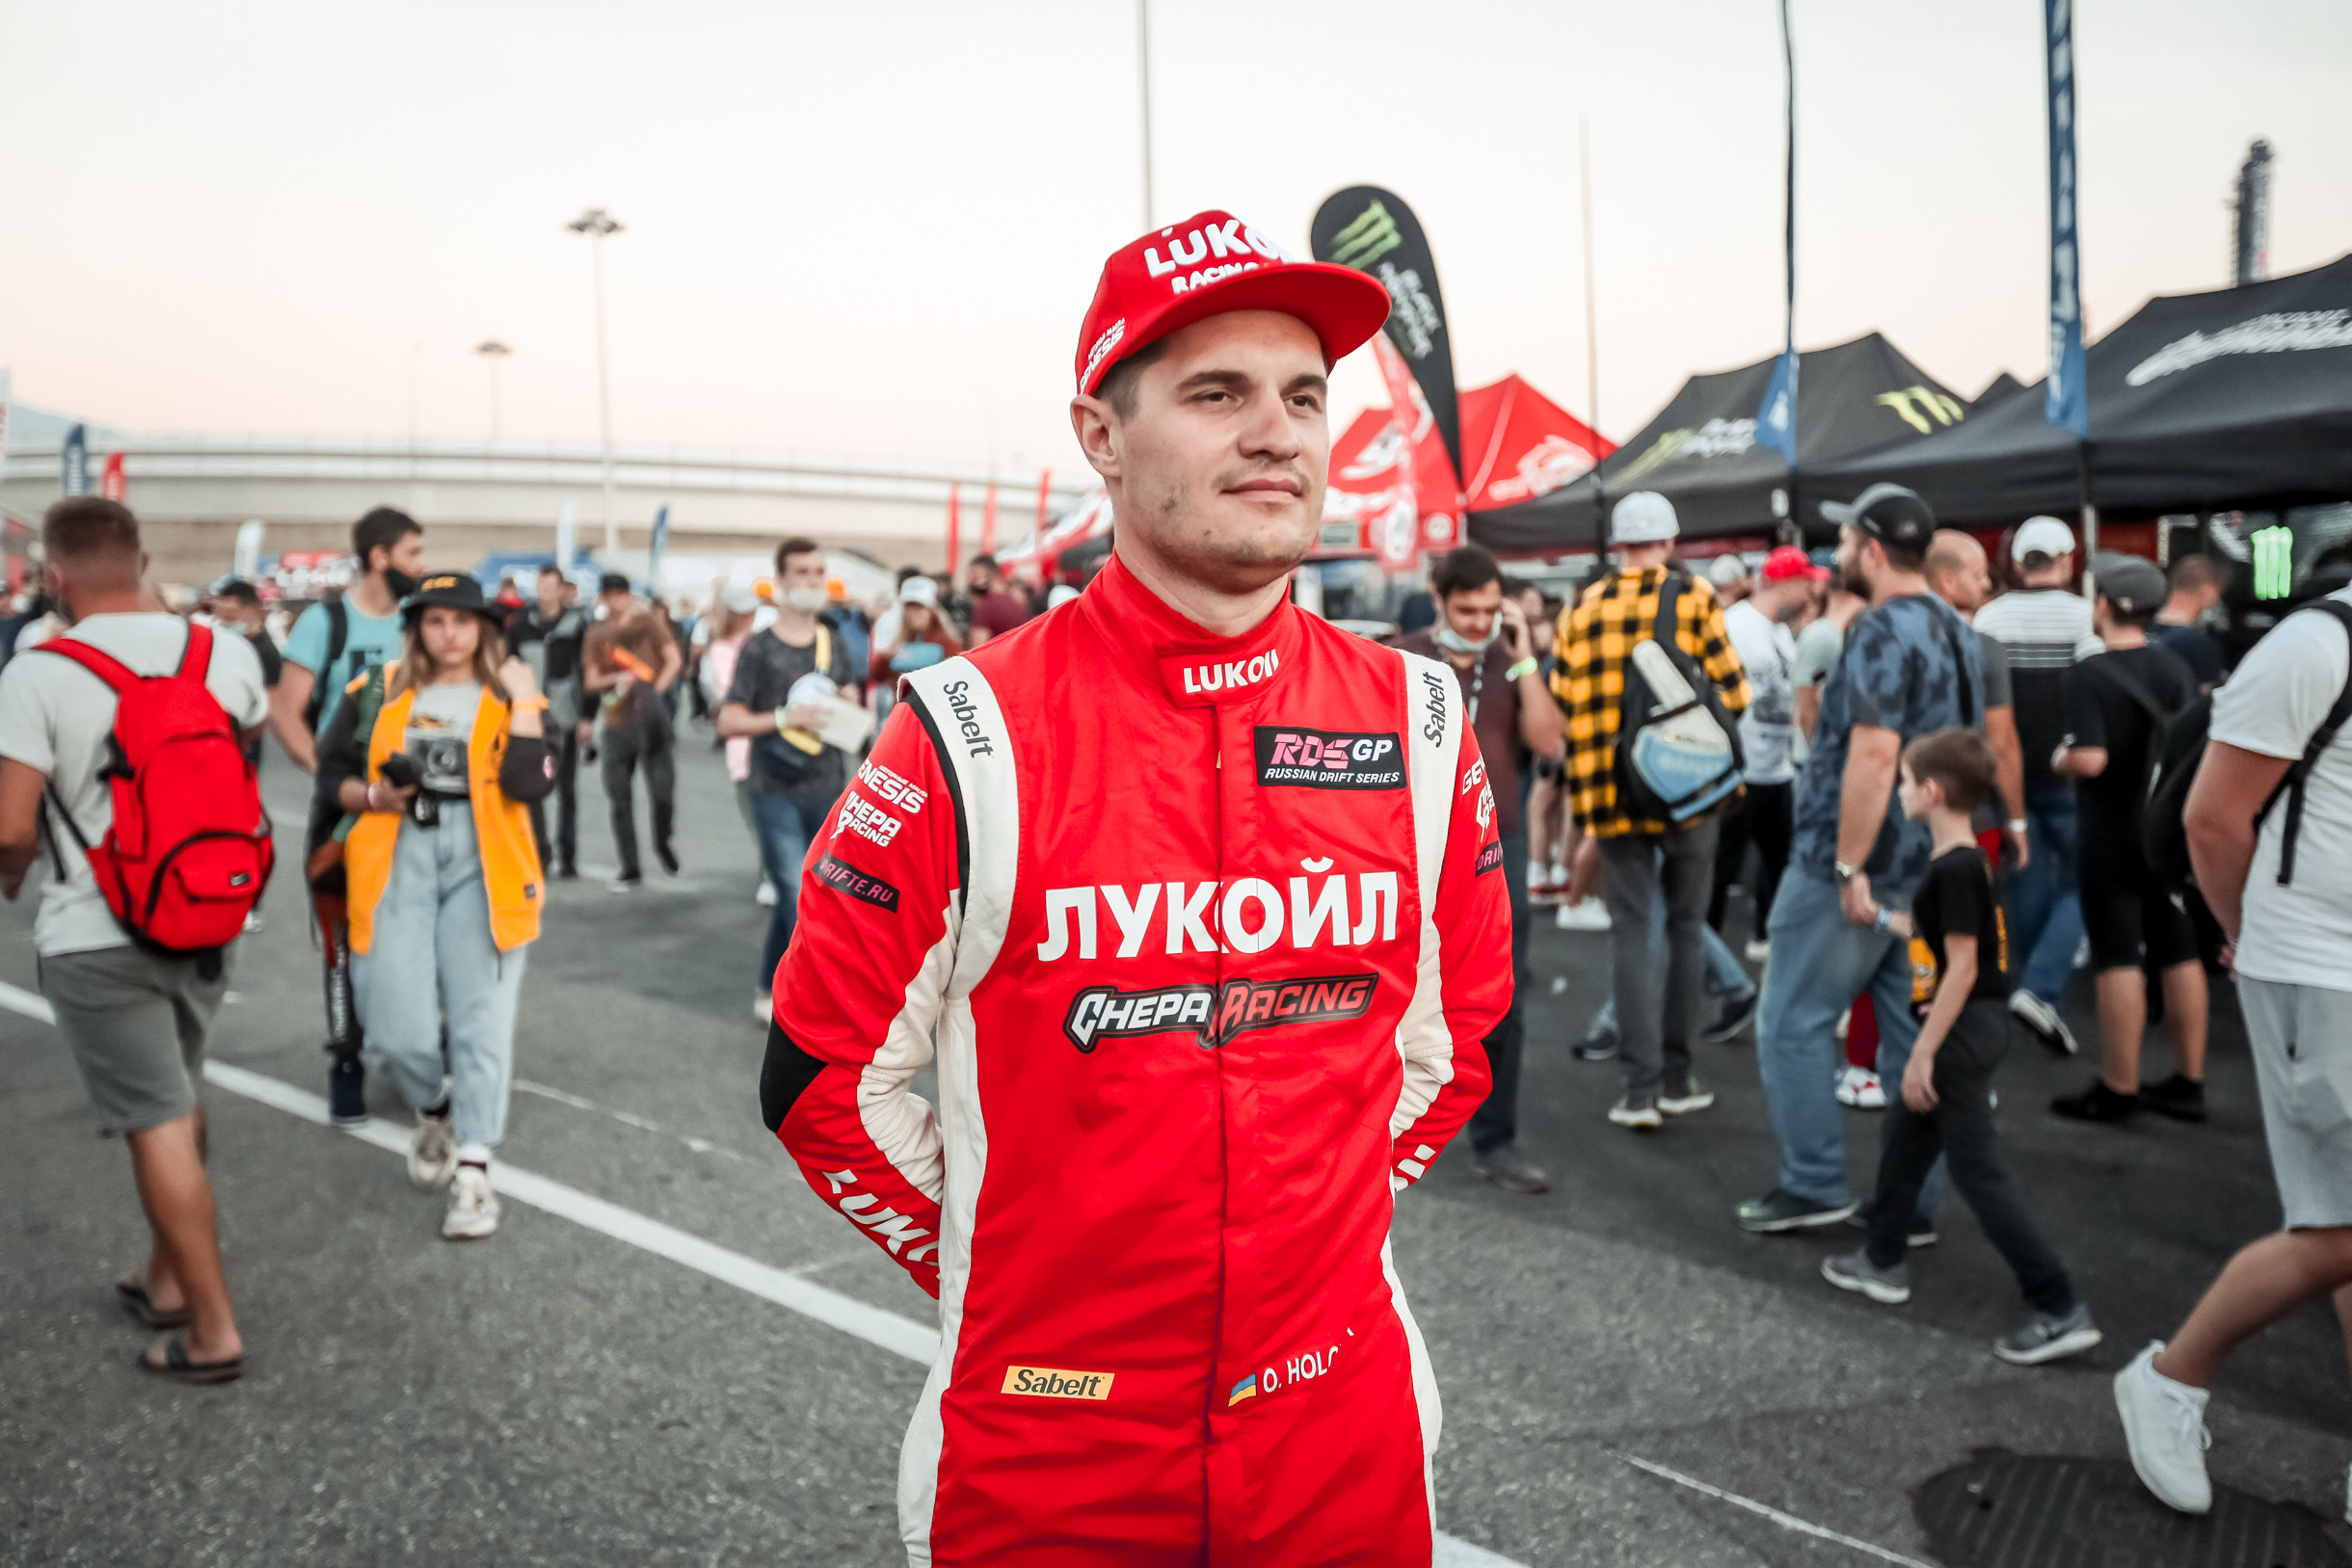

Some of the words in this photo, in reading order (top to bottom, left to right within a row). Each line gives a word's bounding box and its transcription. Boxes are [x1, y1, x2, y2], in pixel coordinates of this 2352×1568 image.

[943, 680, 993, 758] Sabelt
[1423, 671, 1446, 748] Sabelt
[1265, 767, 1318, 782] RUSSIAN
[1319, 772, 1354, 784] DRIFT
[1355, 771, 1401, 784] SERIES
[1270, 733, 1353, 769] RDS
[1352, 739, 1393, 761] GP
[1036, 856, 1400, 961] ЛУКОЙЛ
[1071, 993, 1212, 1046] CHEPA
[1206, 980, 1371, 1040] RACING
[1013, 1369, 1102, 1396] Sabelt
